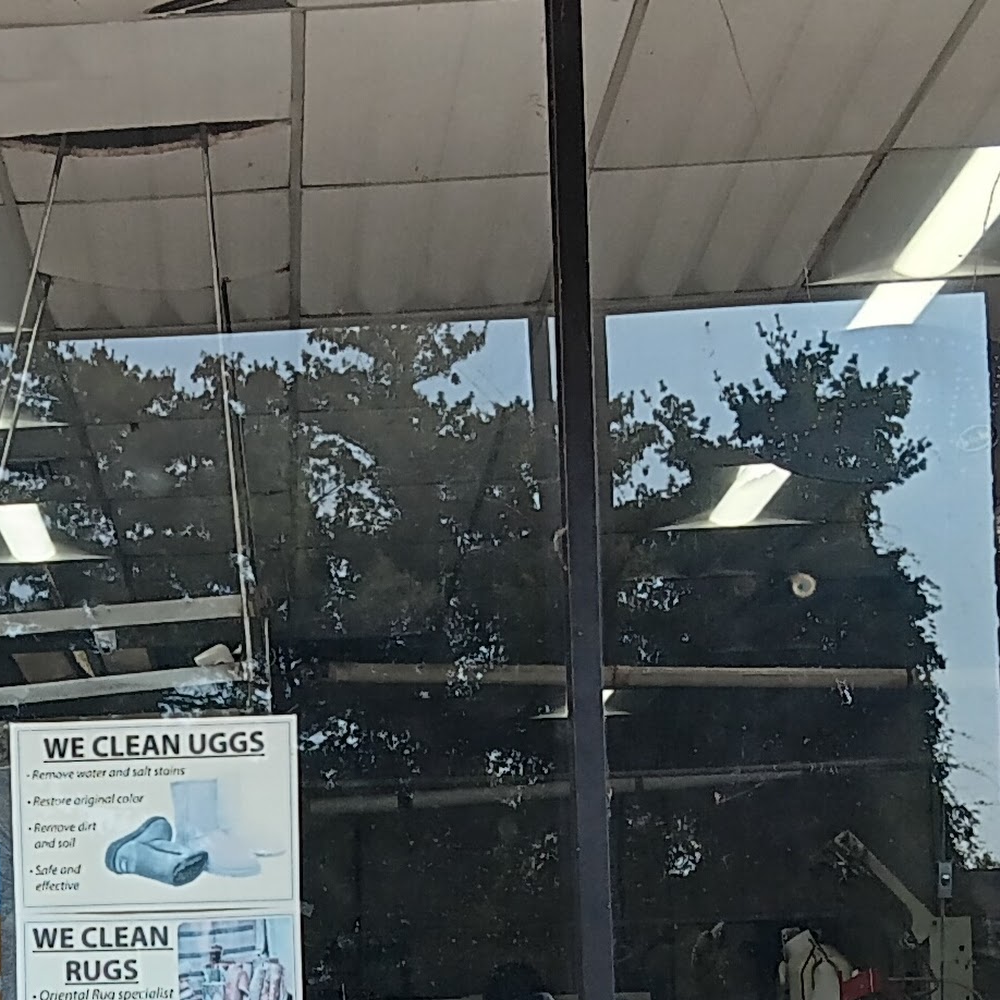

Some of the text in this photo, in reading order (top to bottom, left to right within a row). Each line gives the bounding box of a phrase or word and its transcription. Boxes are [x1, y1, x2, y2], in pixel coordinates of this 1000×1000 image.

[44, 731, 265, 758] WE CLEAN UGGS
[32, 766, 185, 780] Remove water and salt stains
[33, 793, 145, 808] Restore original color
[34, 821, 97, 833] Remove dirt
[34, 837, 76, 849] and soil
[35, 864, 82, 876] Safe and
[35, 880, 80, 891] effective
[32, 926, 169, 949] WE CLEAN
[65, 959, 138, 982] RUGS
[39, 988, 89, 1000] Oriental
